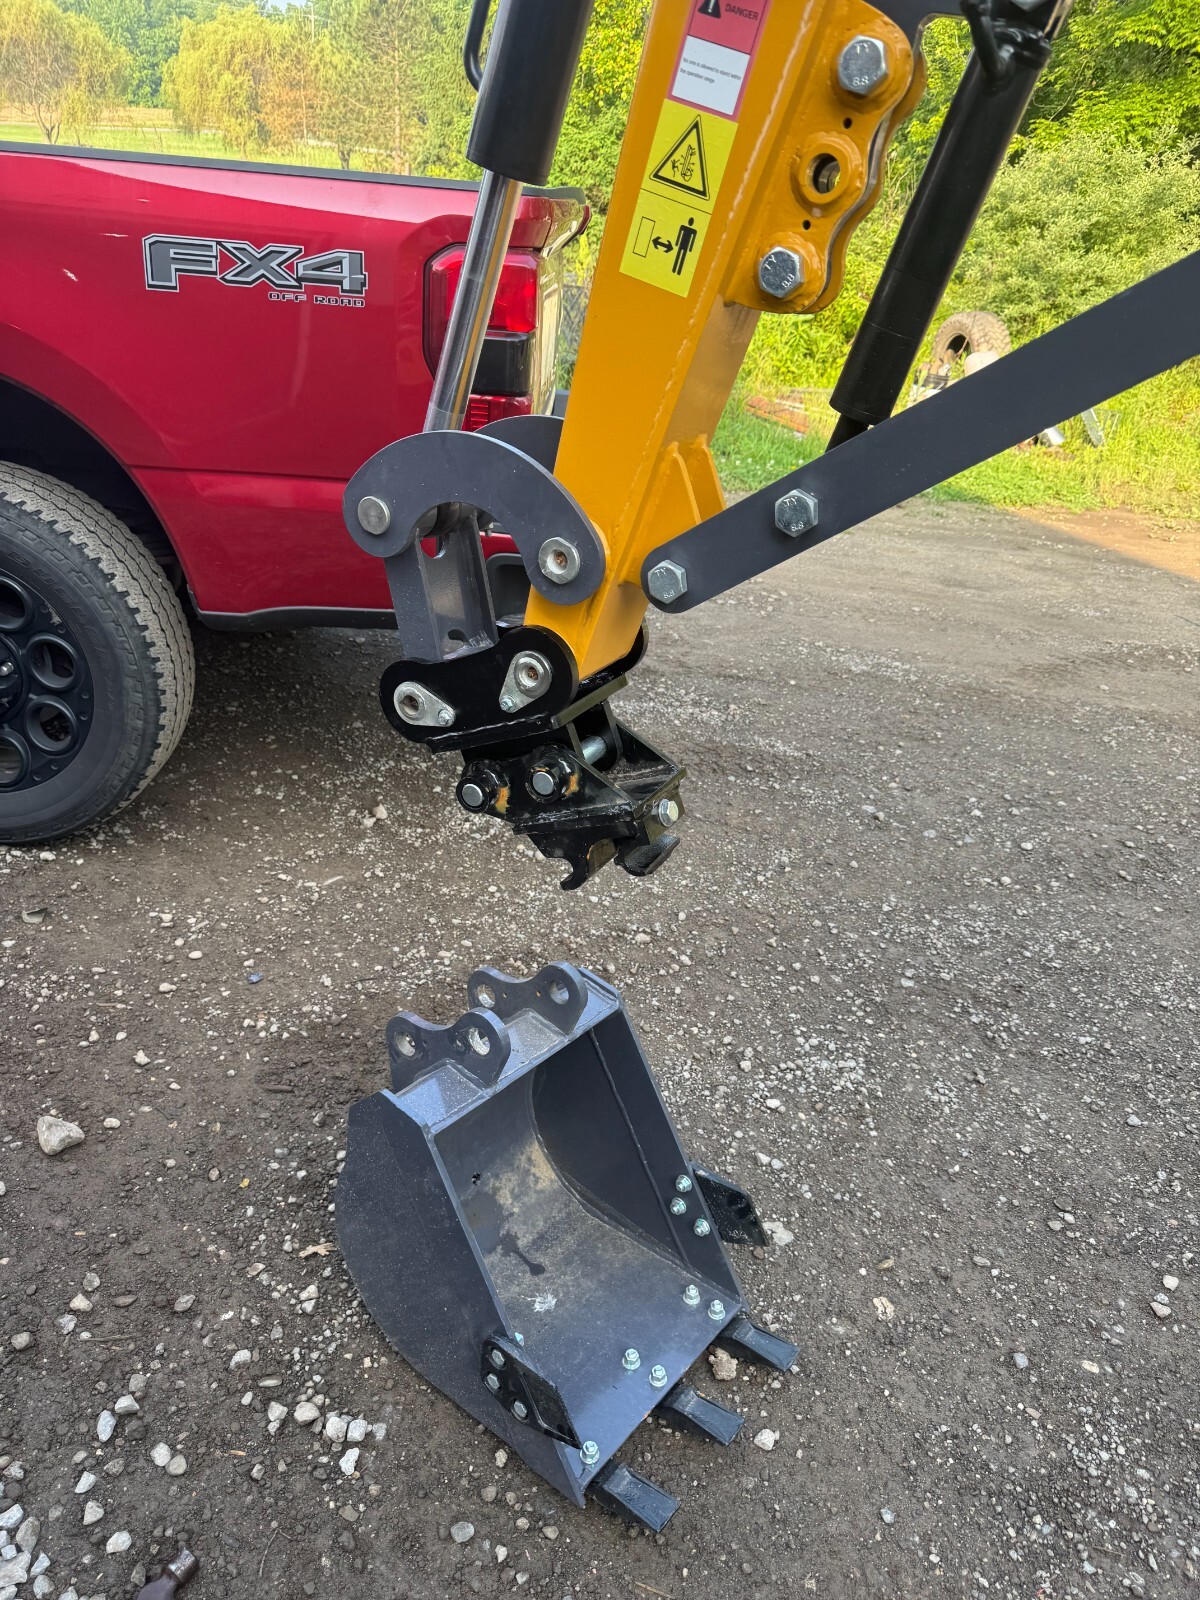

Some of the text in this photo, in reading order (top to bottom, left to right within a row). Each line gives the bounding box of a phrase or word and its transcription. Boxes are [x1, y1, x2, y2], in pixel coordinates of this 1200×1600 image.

[725, 4, 759, 21] DANGER
[142, 233, 368, 296] FX4
[762, 254, 777, 270] TY
[268, 291, 365, 307] OFF ROAD
